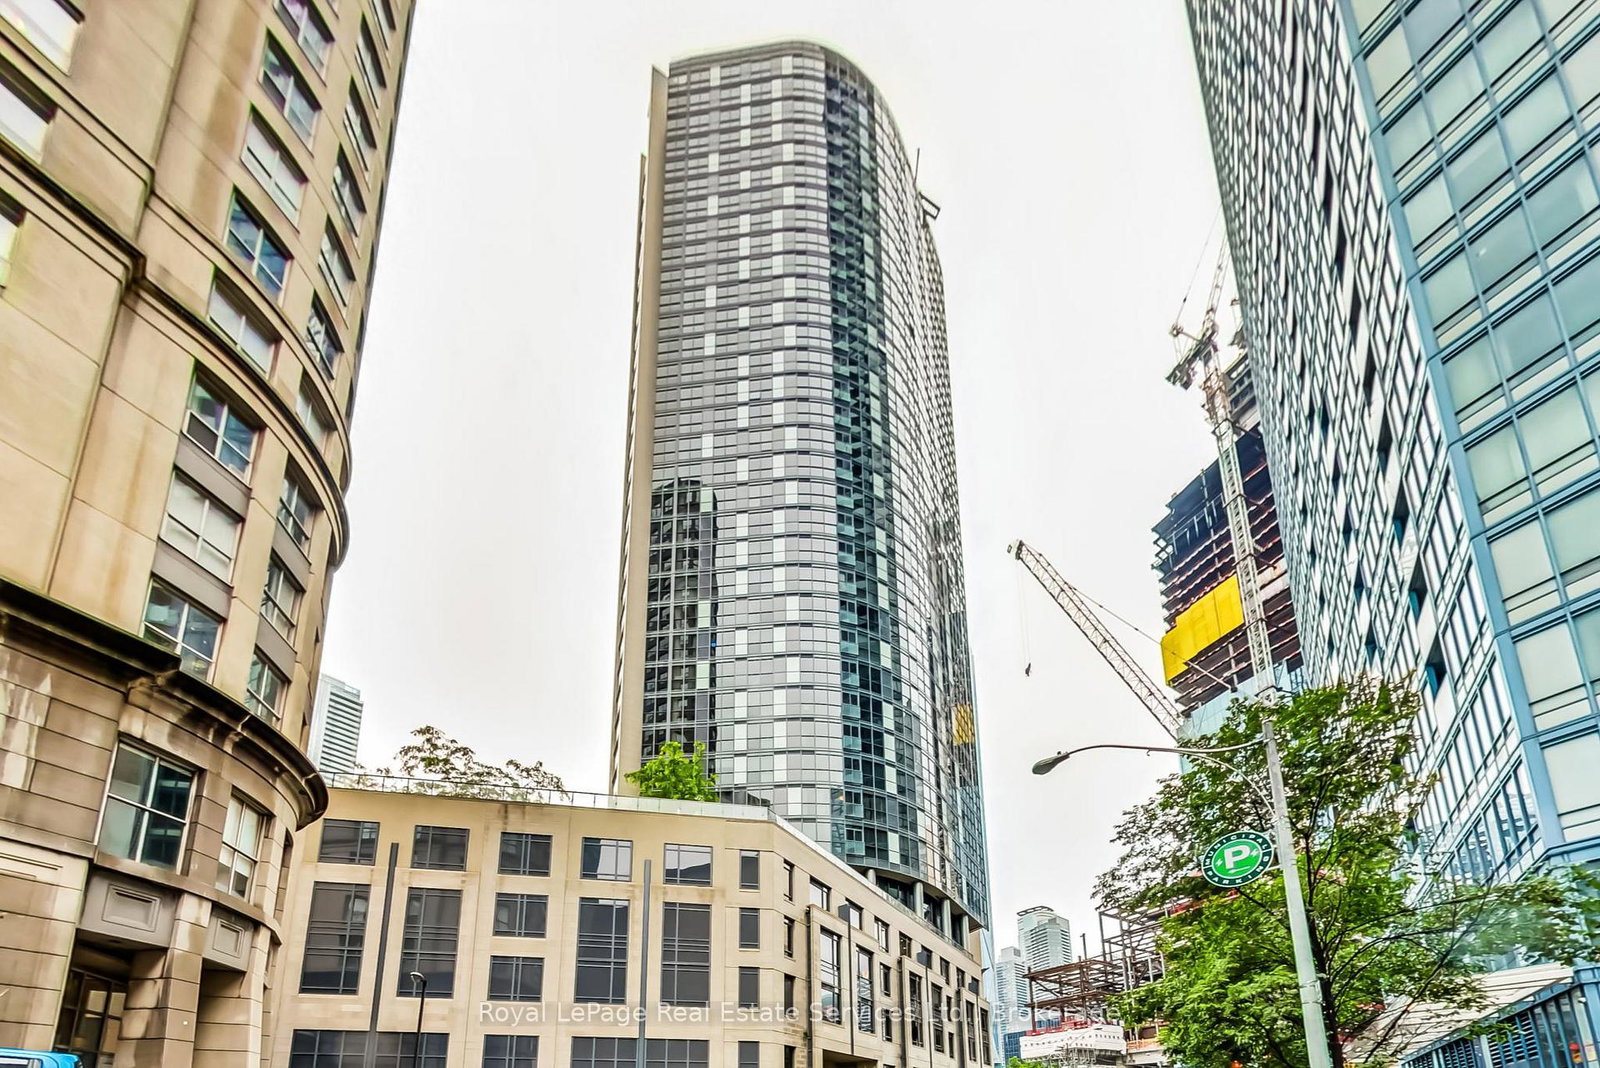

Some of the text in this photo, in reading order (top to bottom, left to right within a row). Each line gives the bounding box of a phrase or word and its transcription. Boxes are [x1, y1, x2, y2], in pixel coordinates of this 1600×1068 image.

[1205, 834, 1268, 865] MUNICIPAL
[1224, 845, 1250, 869] P
[1207, 856, 1269, 884] PARKING
